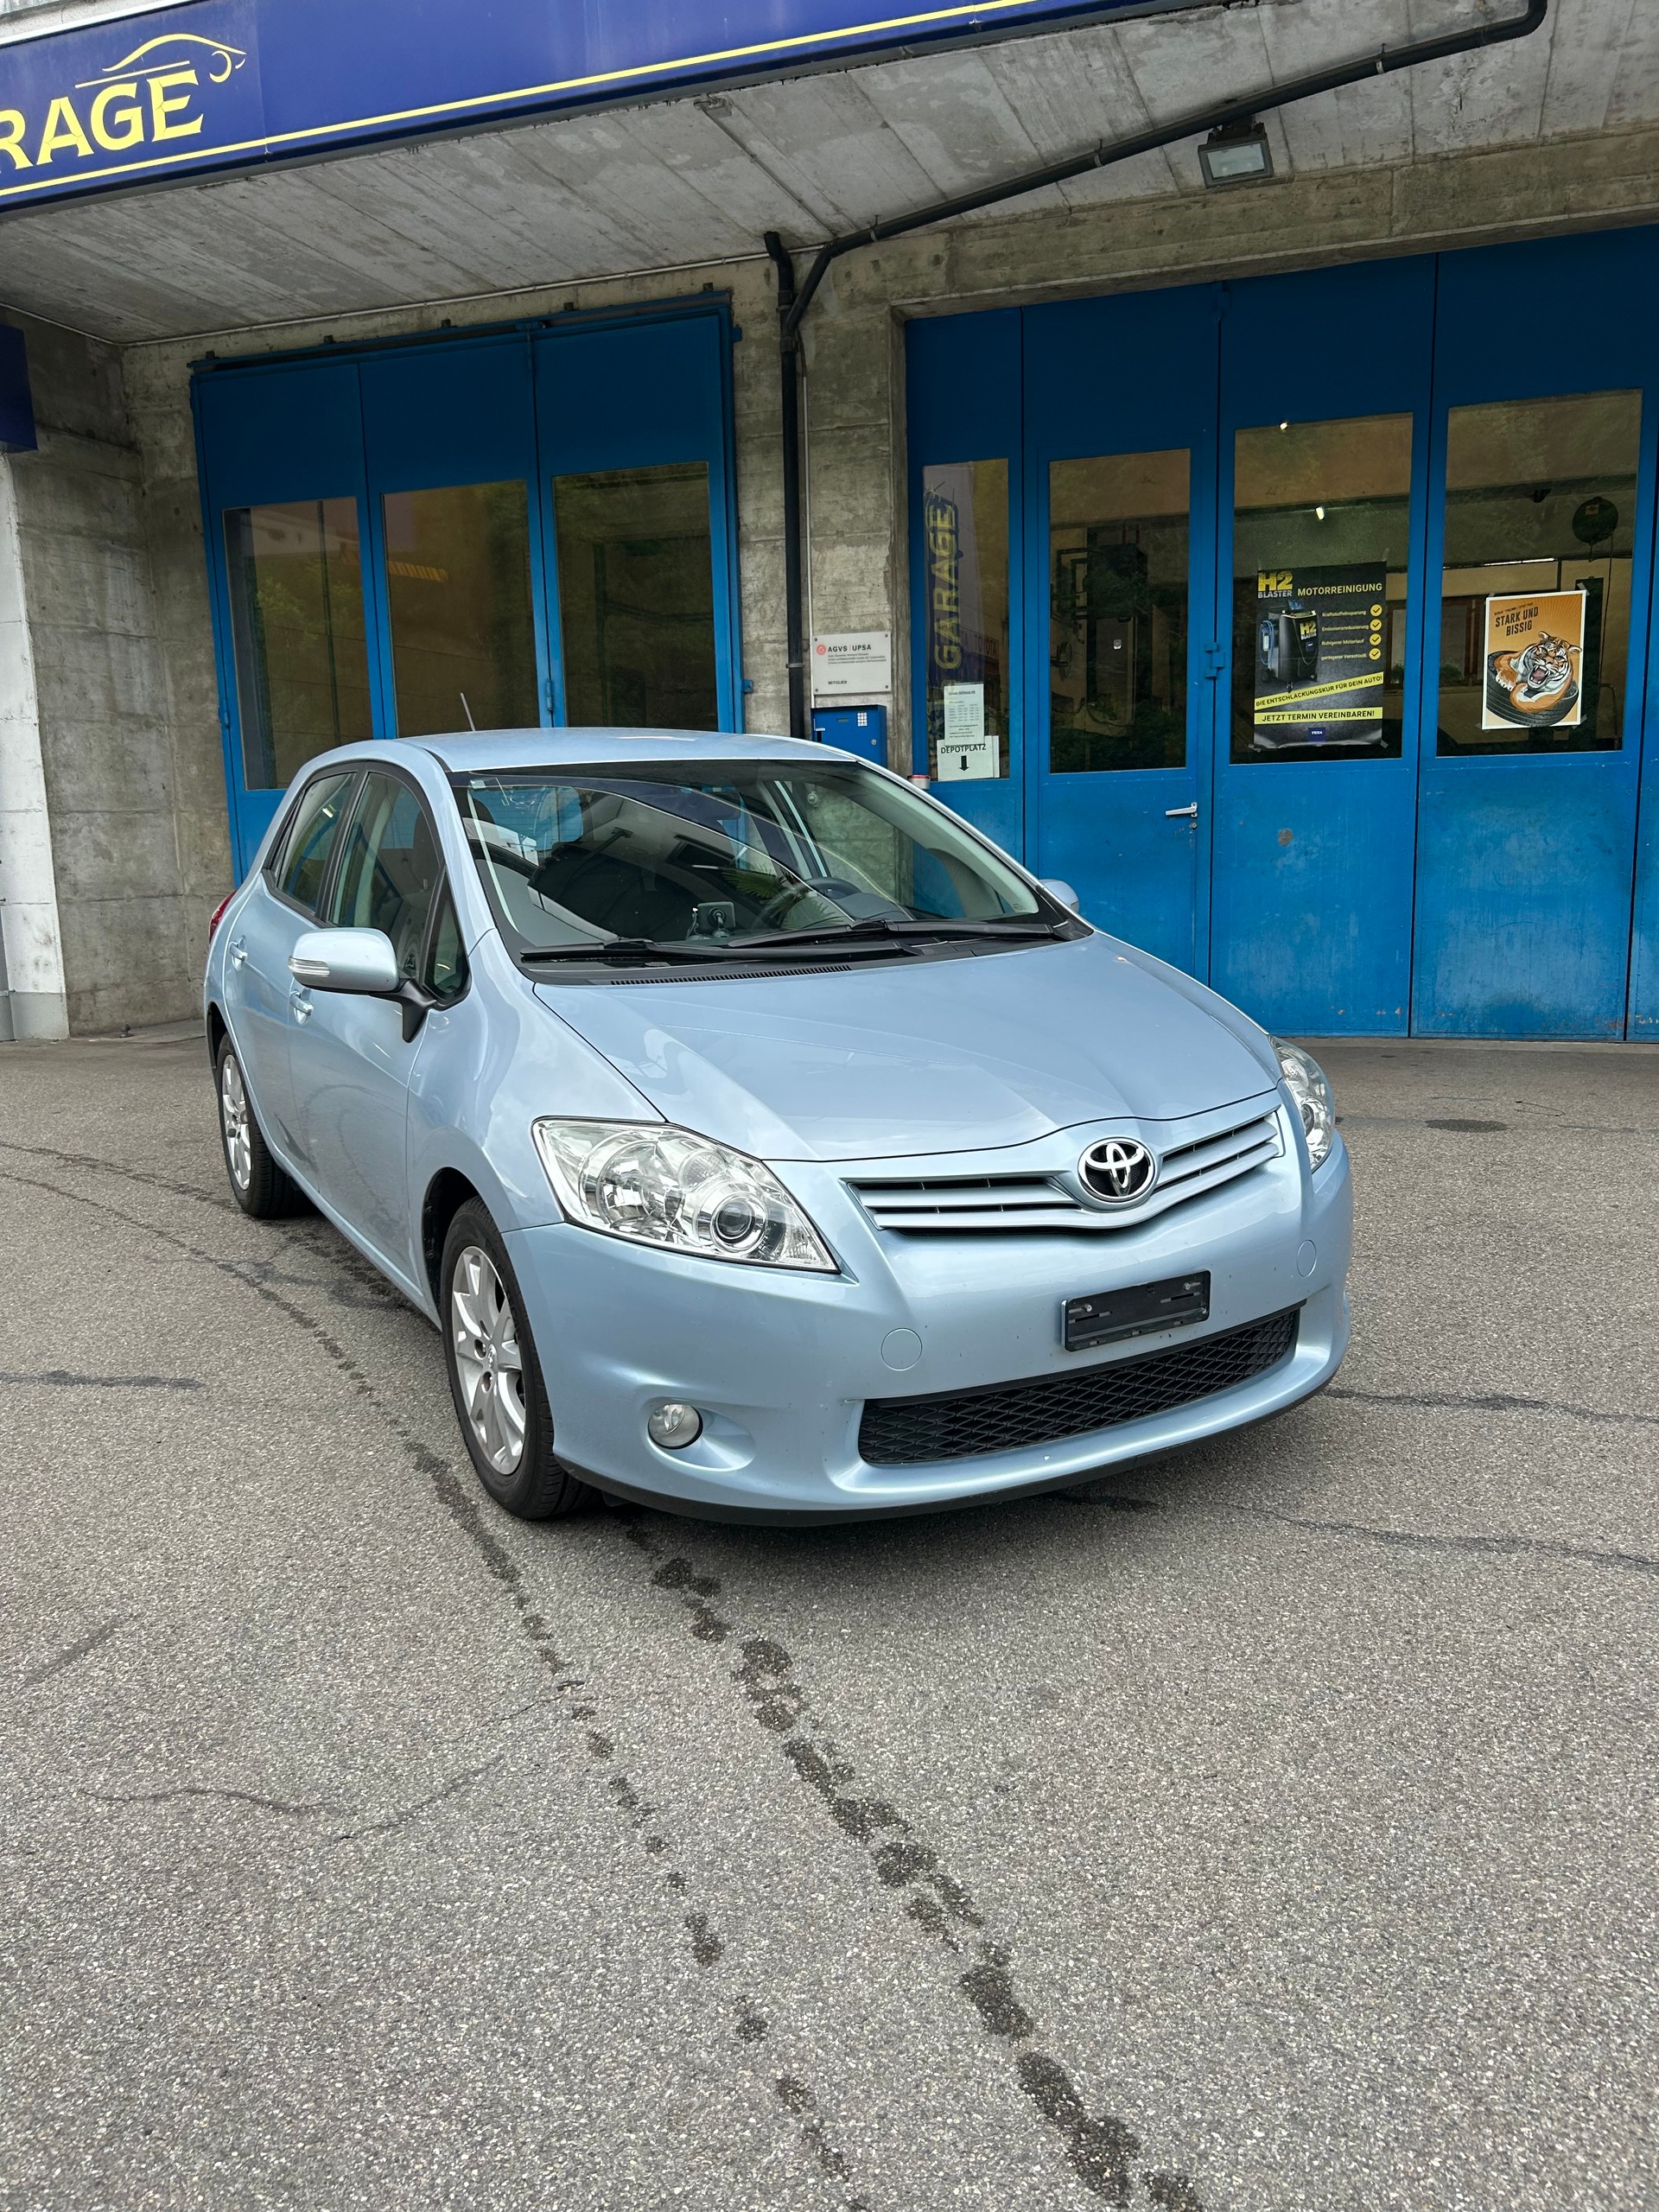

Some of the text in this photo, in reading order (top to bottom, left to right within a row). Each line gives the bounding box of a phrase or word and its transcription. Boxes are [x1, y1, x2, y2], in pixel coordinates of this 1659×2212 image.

[928, 502, 962, 671] GARAGE
[1258, 570, 1293, 592] H2
[1258, 590, 1293, 599] BLASTER
[1297, 582, 1382, 597] MOTORREINIGUNG
[1496, 612, 1521, 628] STARK
[1522, 607, 1538, 620] UND
[1300, 621, 1317, 635] H2
[1506, 620, 1532, 636] BISSIG
[1266, 685, 1335, 705] ENTSCHLACKUNGSKUR
[1335, 682, 1348, 690] FÜR
[1348, 678, 1363, 688] DEIN
[1363, 675, 1382, 684] AUTO!
[1262, 714, 1286, 722] JETZT
[1319, 710, 1375, 720] VEREINBAREN!
[940, 743, 987, 754] DEPOTPLATZ
